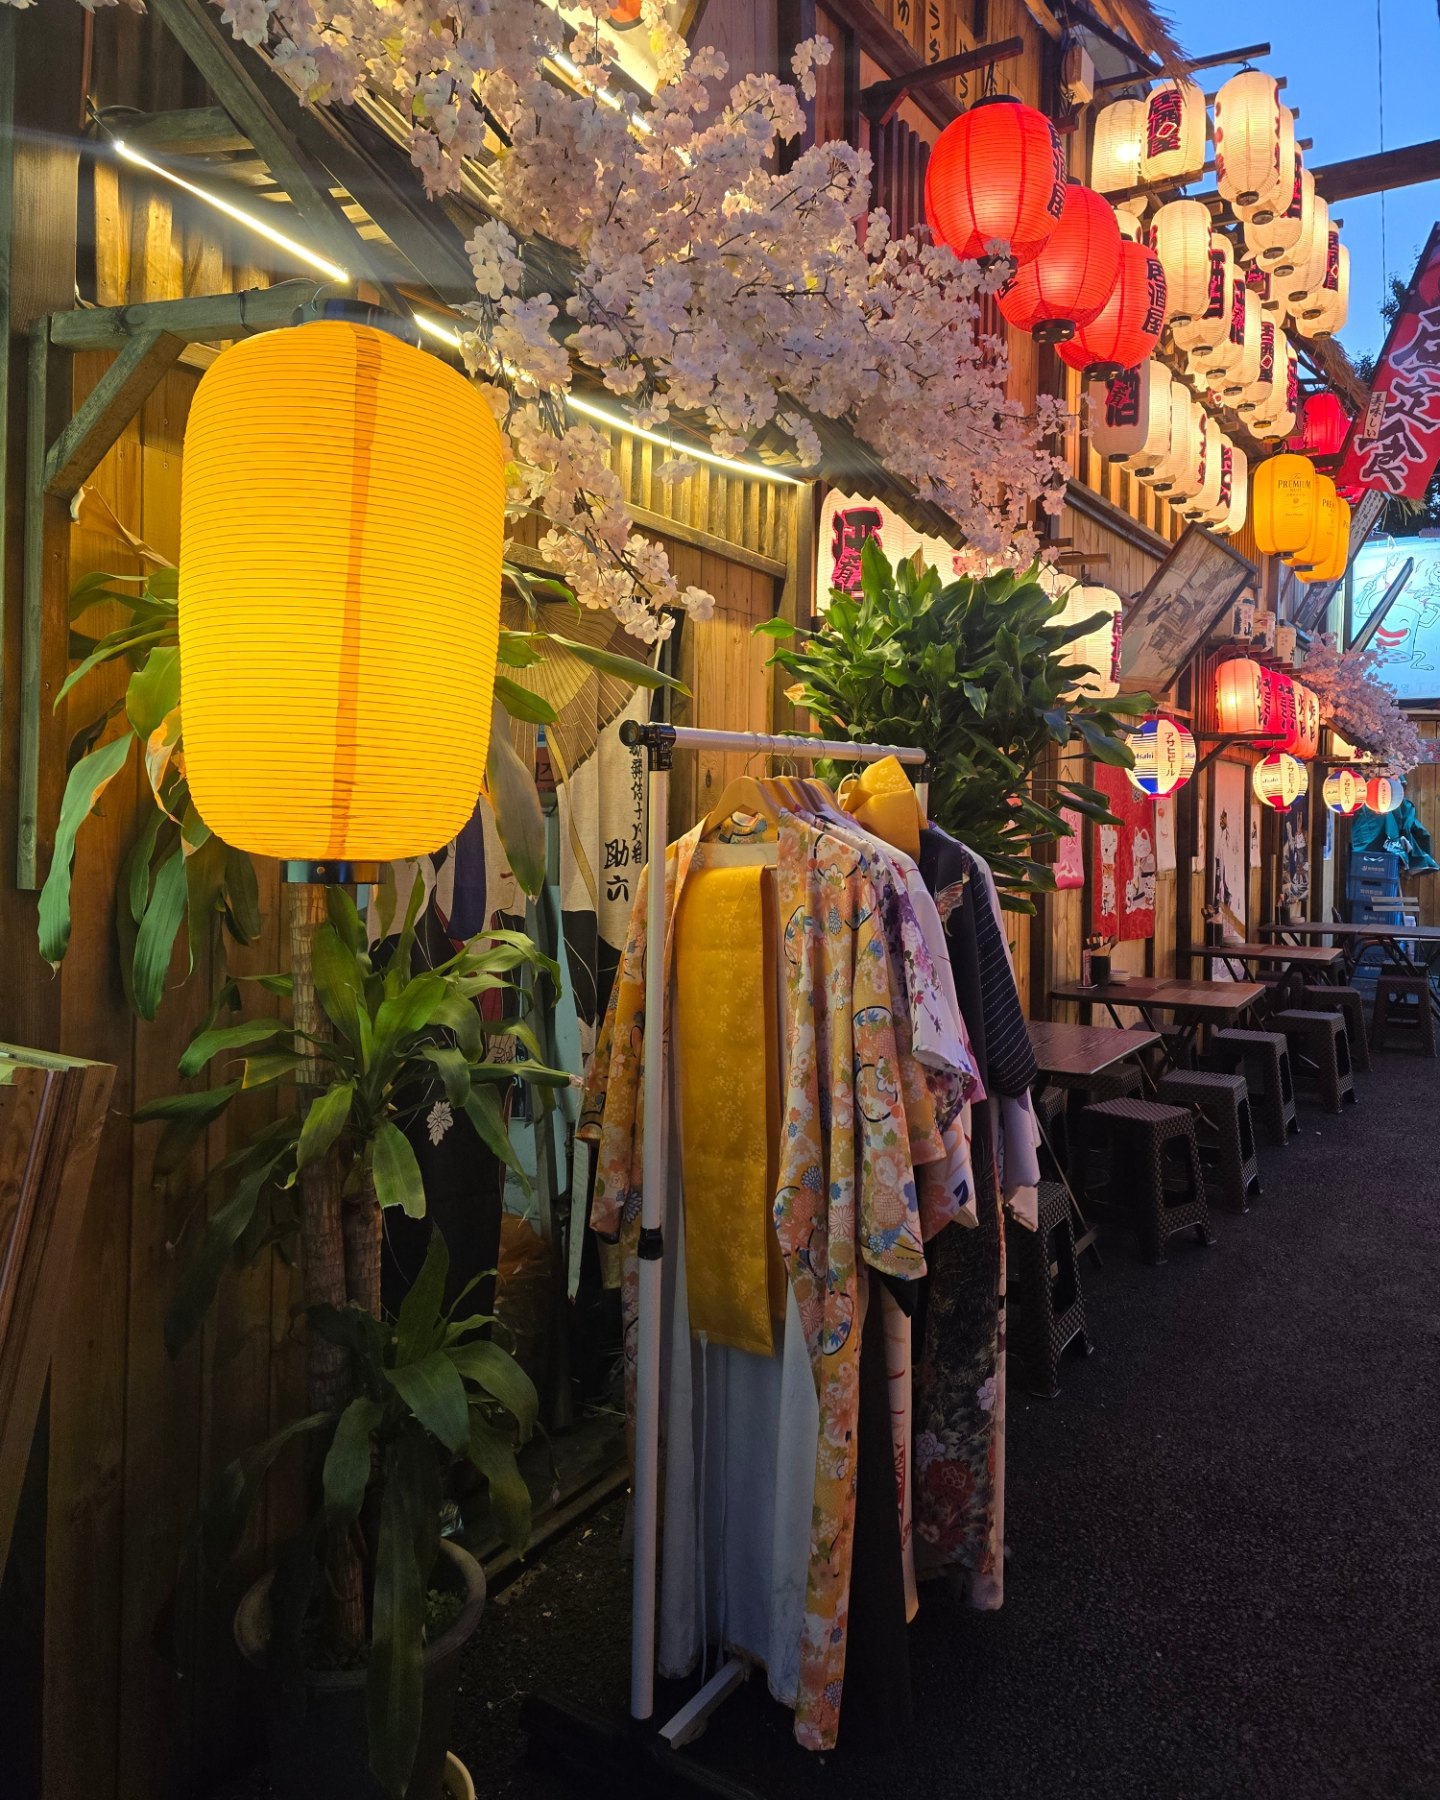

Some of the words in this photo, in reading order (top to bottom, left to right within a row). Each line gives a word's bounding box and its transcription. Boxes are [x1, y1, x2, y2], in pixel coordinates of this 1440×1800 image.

[1146, 89, 1183, 160] 居酒屋
[1142, 258, 1168, 336] 居酒屋
[1366, 393, 1383, 438] 美味しい
[1278, 480, 1311, 488] PREMIUM
[1164, 731, 1176, 777] アサヒビール
[1286, 761, 1295, 794] アサヒビール
[604, 838, 630, 902] 助六
